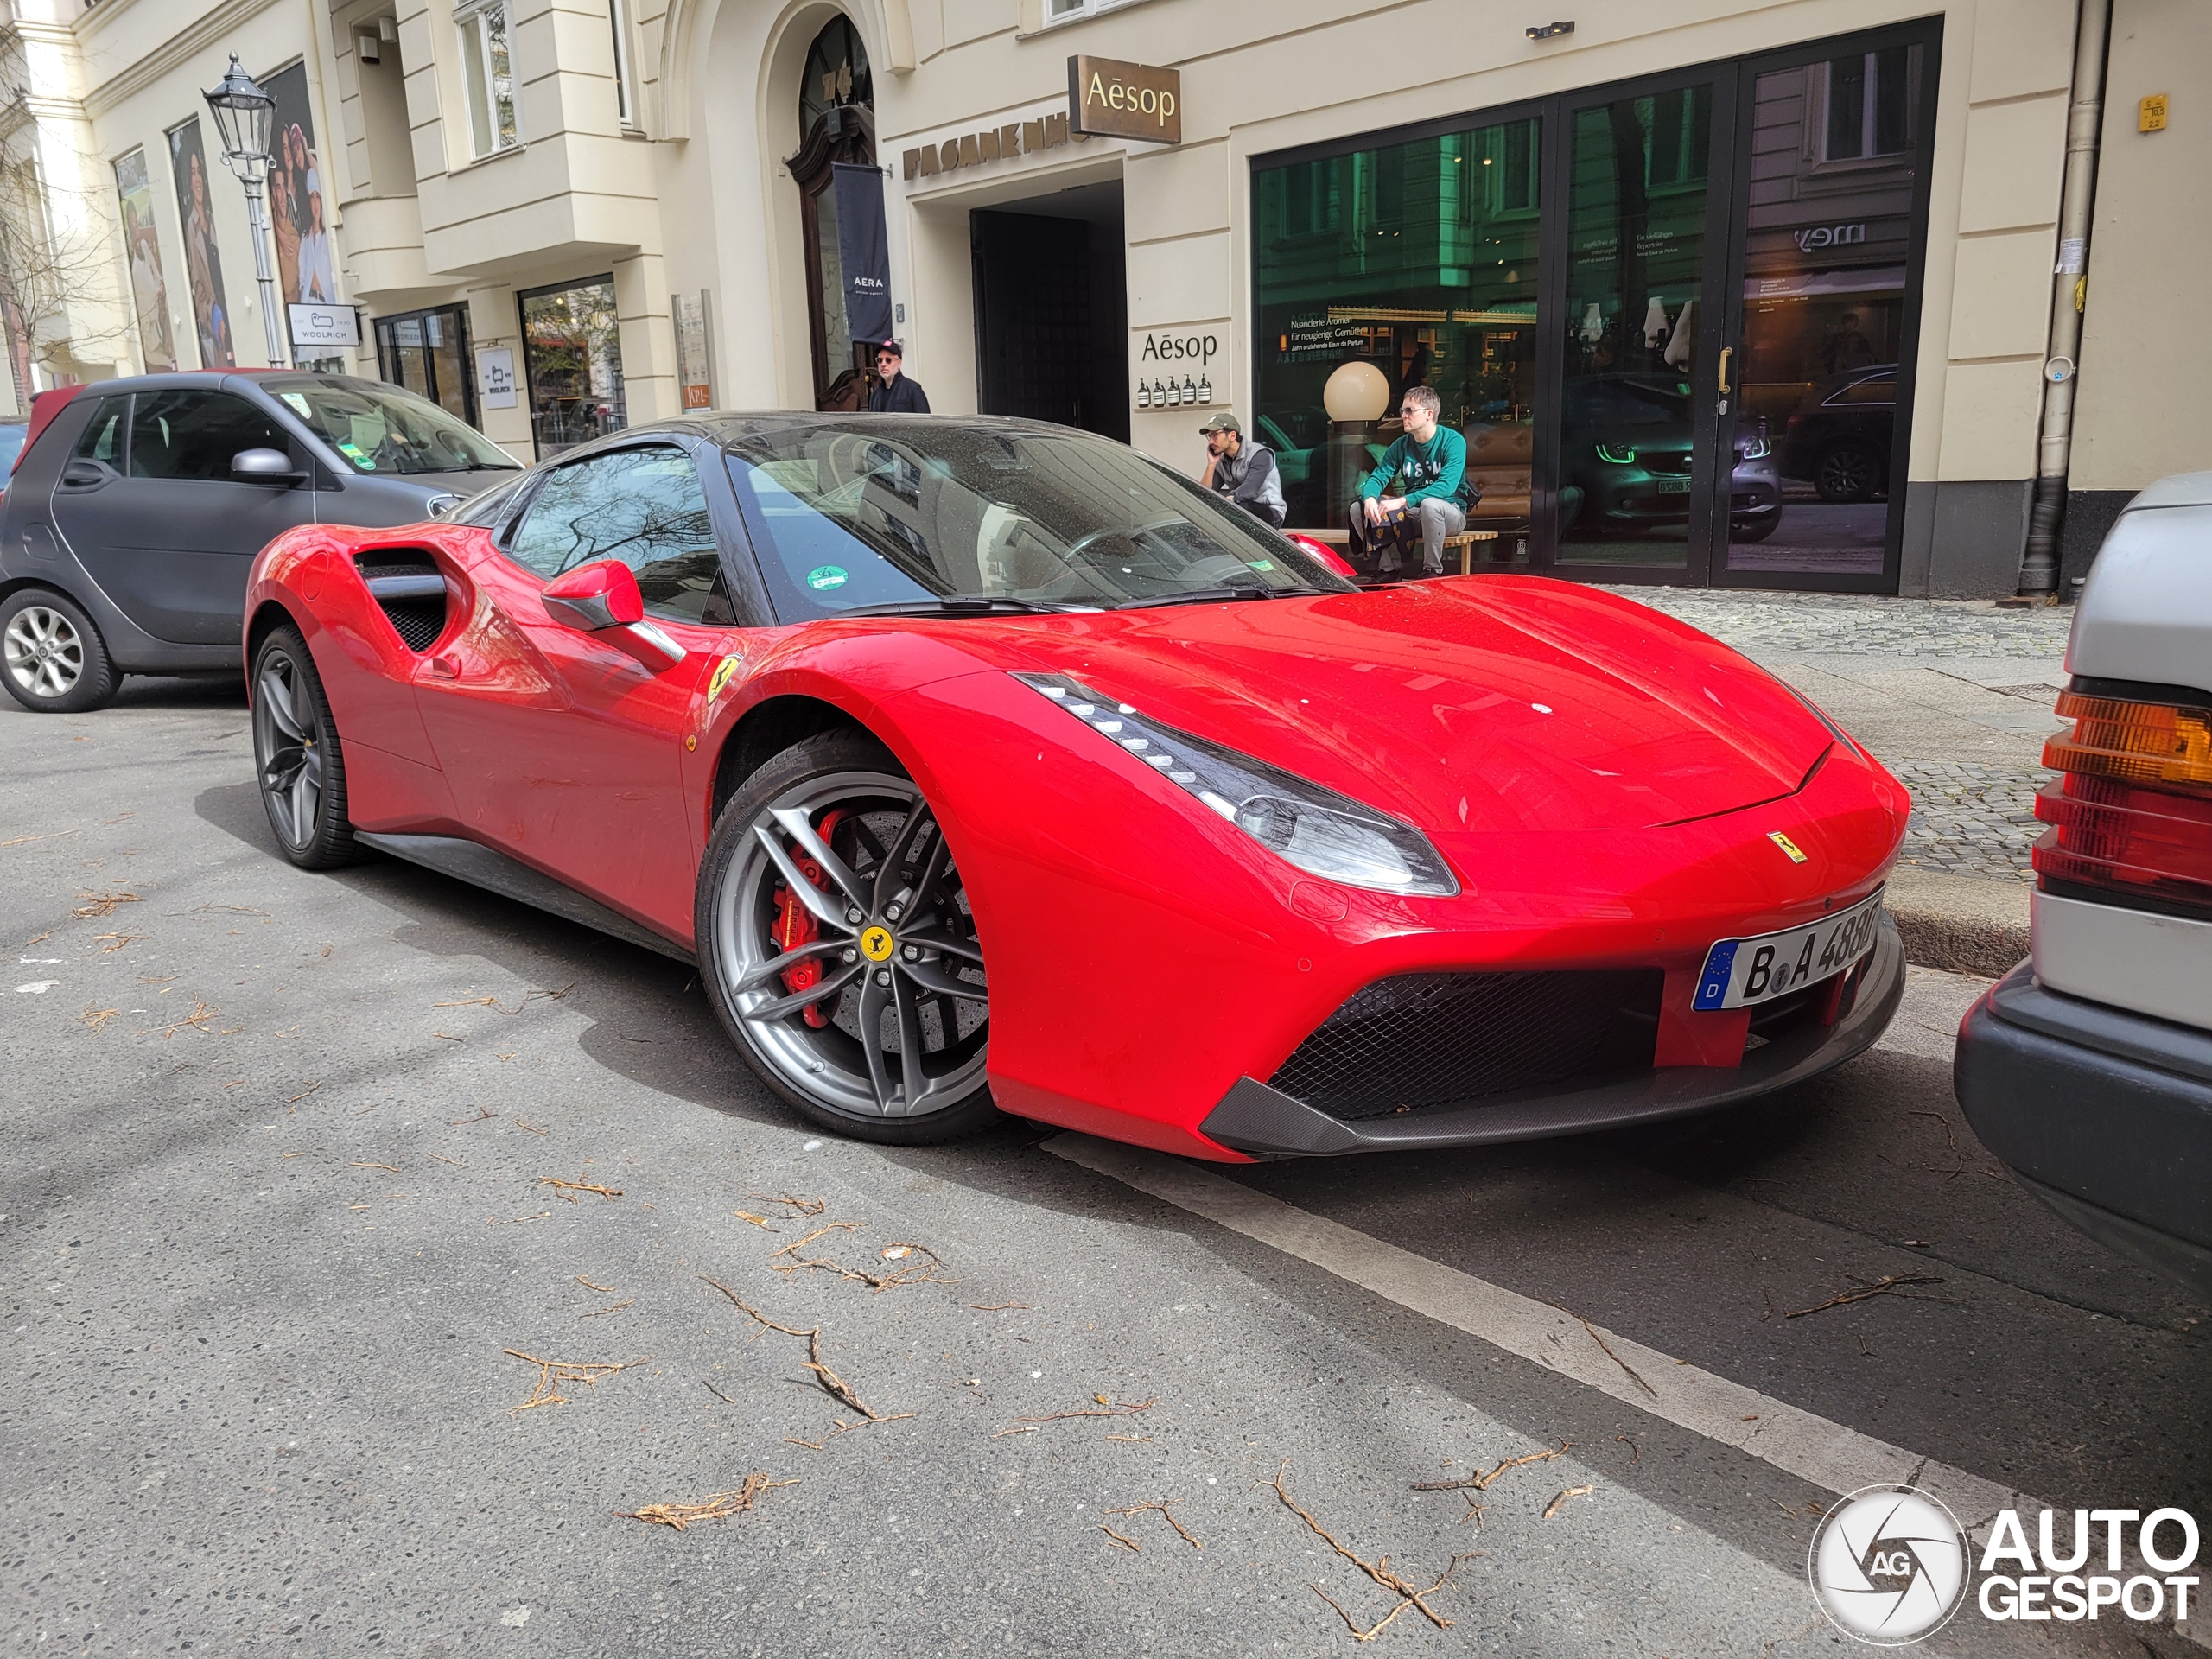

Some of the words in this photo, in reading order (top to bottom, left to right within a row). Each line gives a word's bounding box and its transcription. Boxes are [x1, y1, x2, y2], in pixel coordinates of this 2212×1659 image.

[1087, 71, 1175, 126] Aēsop
[854, 276, 884, 288] AERA
[1290, 318, 1325, 329] Nuancierte
[1326, 317, 1352, 326] Aromen
[302, 331, 347, 339] WOOLRICH
[1291, 332, 1300, 341] für
[1301, 330, 1333, 342] neugierige
[1142, 334, 1217, 366] Aēsop
[791, 906, 800, 944] Ferrari
[1743, 945, 1775, 999] B
[1790, 932, 1816, 985] A
[1706, 984, 1719, 998] D
